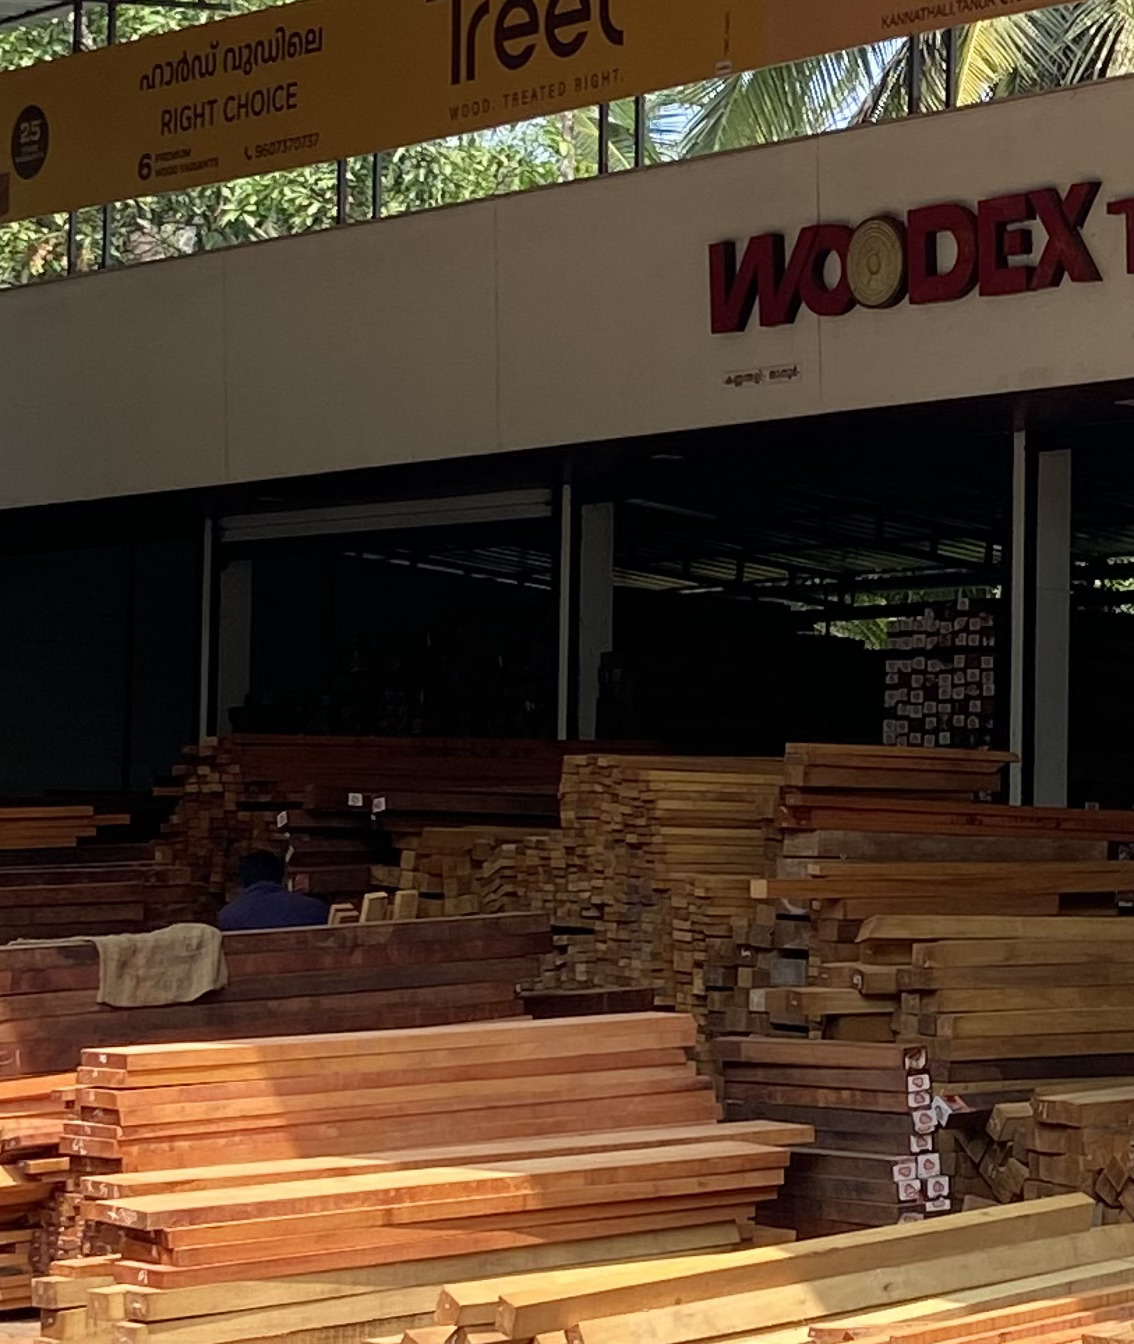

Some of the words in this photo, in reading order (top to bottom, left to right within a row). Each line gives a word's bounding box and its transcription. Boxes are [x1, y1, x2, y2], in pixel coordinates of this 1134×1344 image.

[160, 99, 218, 136] RIGHT
[223, 81, 298, 123] CHOICE
[503, 82, 566, 109] TREATED
[19, 119, 42, 144] 25
[138, 153, 152, 181] 6
[708, 181, 1103, 334] WOODEX
